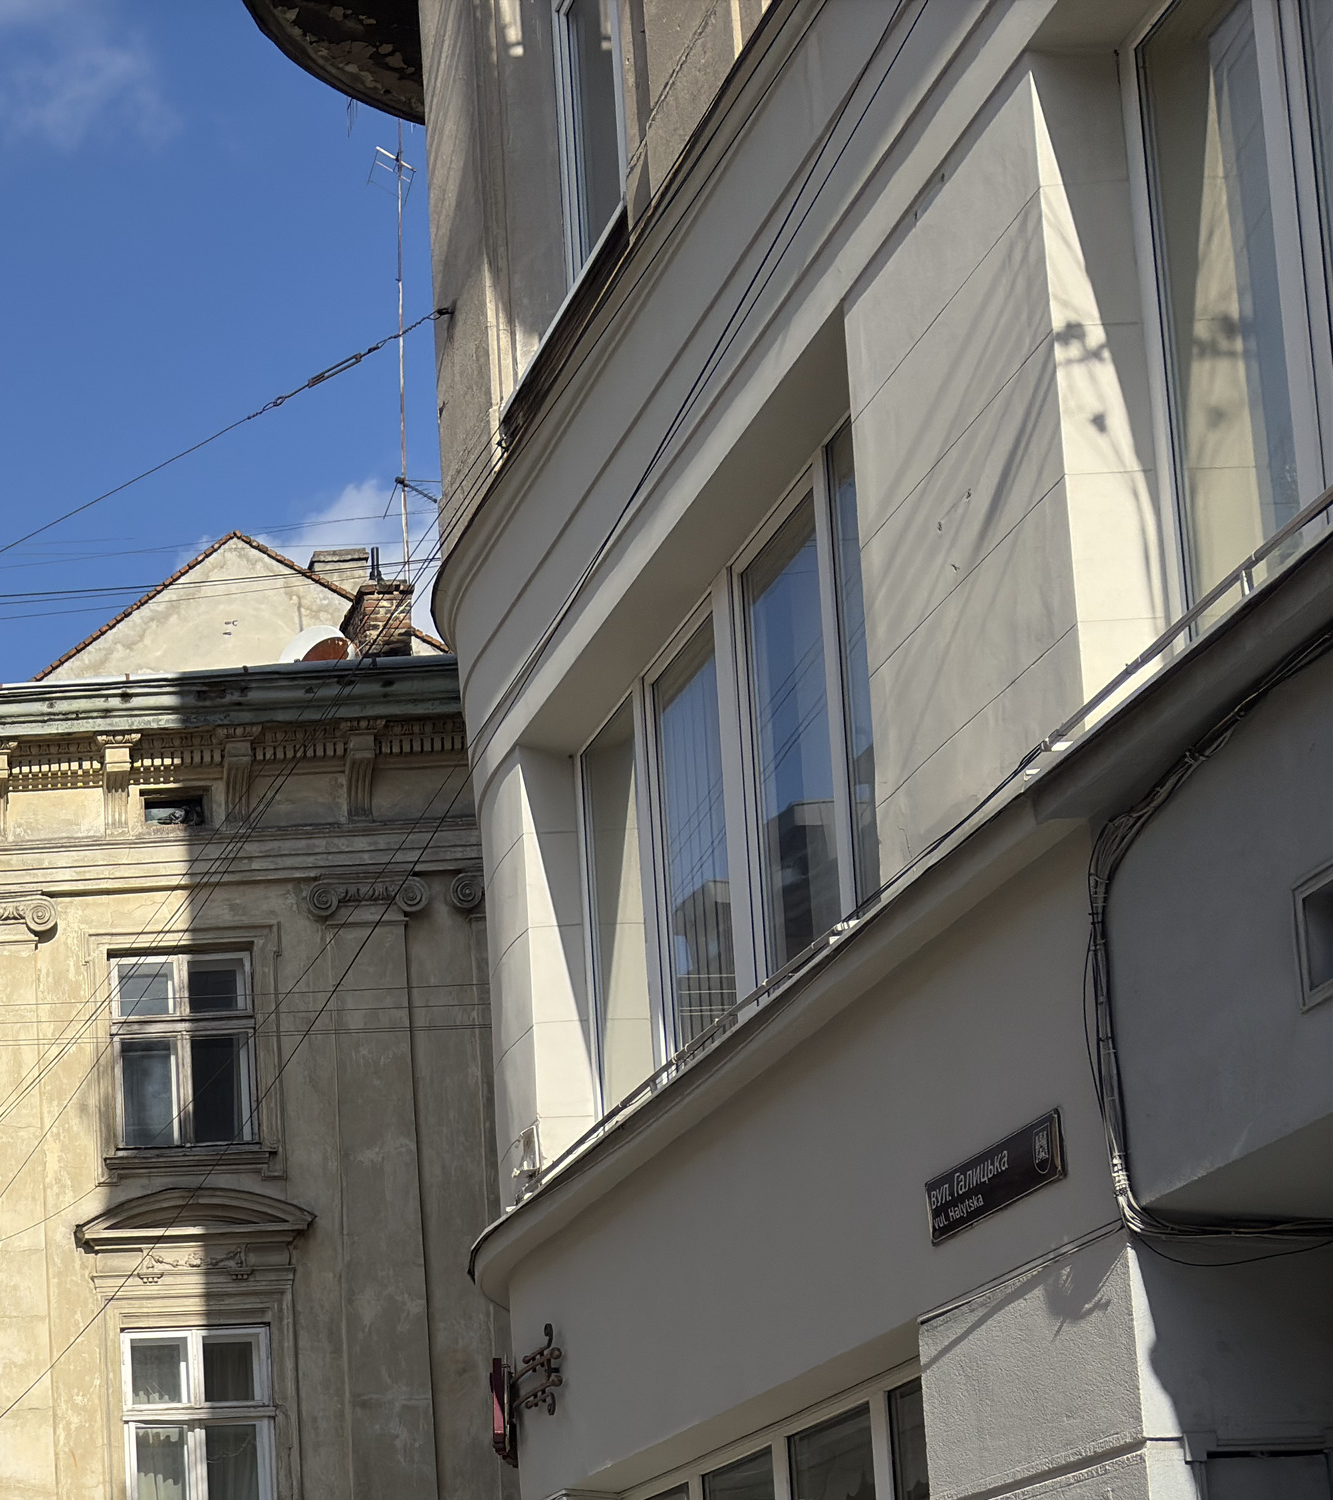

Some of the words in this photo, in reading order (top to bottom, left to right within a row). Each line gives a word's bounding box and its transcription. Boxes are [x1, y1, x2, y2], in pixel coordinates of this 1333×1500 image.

[930, 1184, 952, 1209] вул.
[954, 1150, 1009, 1197] Галицька
[933, 1215, 949, 1230] vul.
[948, 1194, 984, 1221] Halytska
